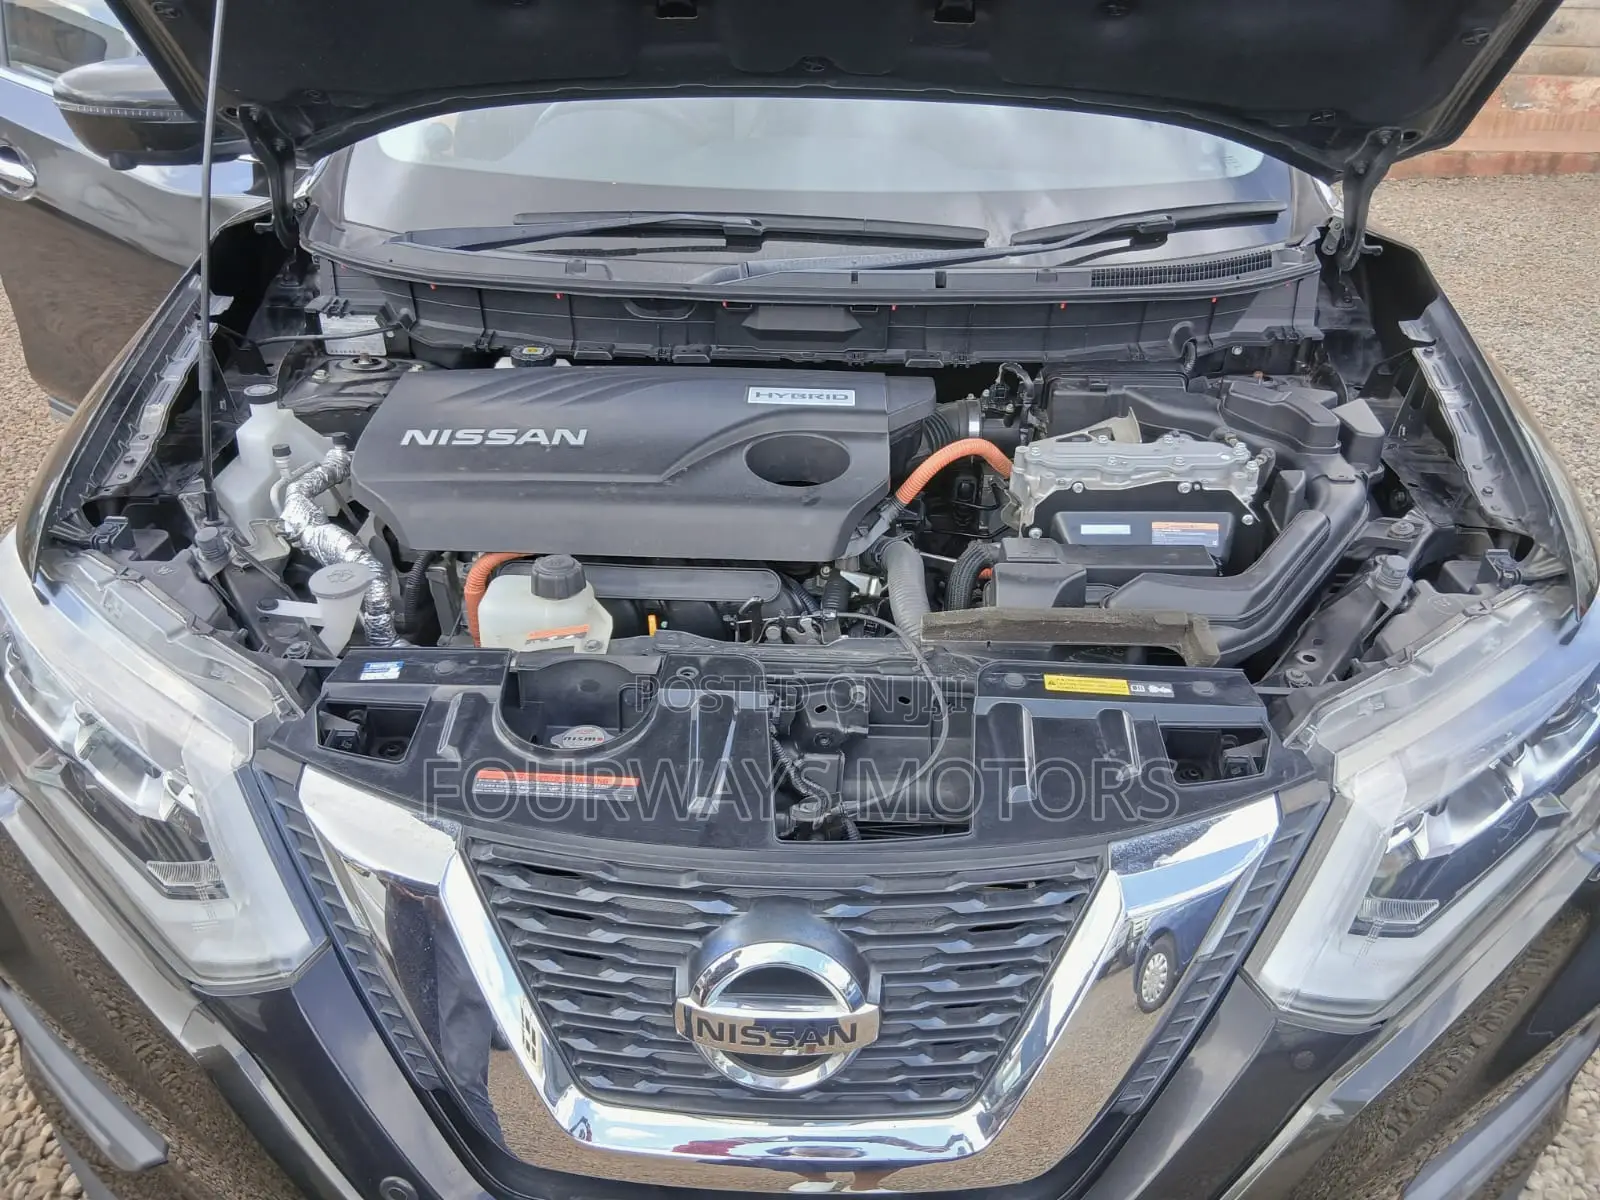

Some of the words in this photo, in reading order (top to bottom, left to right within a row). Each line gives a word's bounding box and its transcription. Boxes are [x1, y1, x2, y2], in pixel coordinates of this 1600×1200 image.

[755, 391, 849, 401] HYBRID
[400, 428, 588, 446] NISSAN
[696, 1017, 857, 1048] NISSAN
